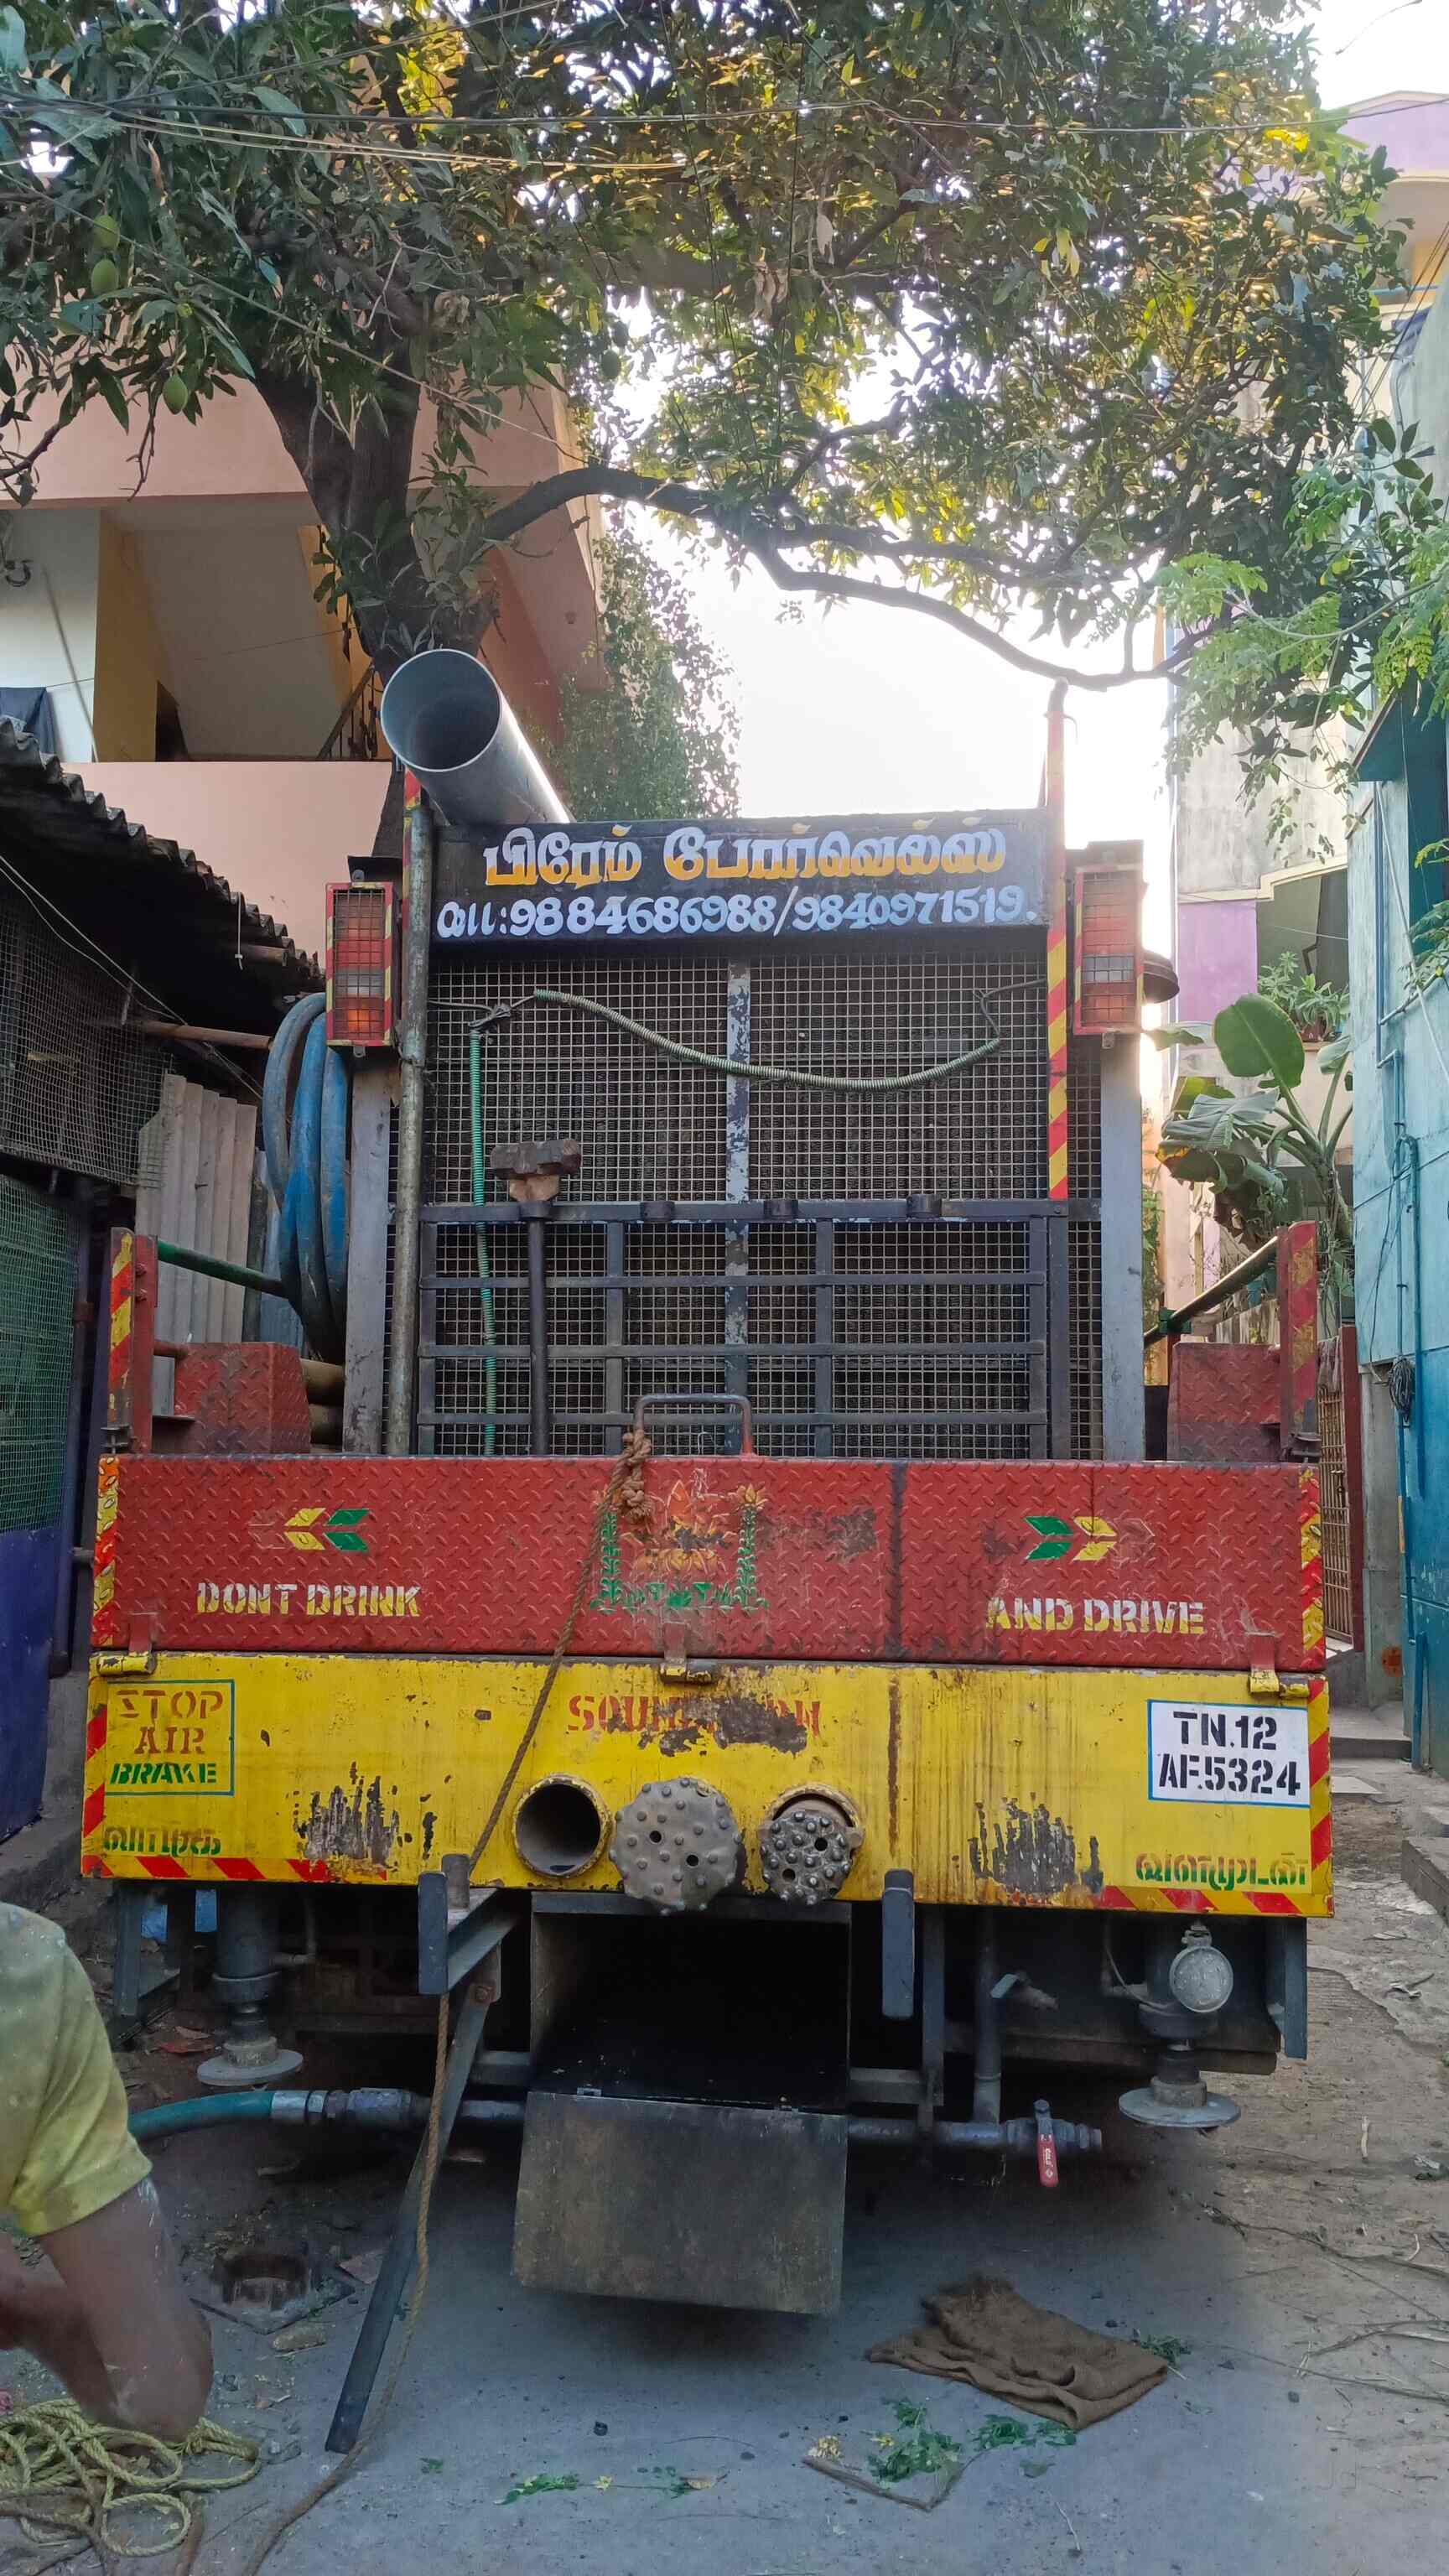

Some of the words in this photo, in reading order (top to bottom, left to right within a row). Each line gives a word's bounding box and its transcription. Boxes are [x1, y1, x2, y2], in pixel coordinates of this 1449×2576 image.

[483, 823, 642, 890] பிரேம்
[197, 1581, 298, 1615] DONT
[307, 1583, 421, 1617] DRINK
[986, 1597, 1074, 1631] AND
[1083, 1598, 1205, 1634] DRIVE
[116, 1690, 224, 1719] STOP
[134, 1726, 205, 1754] AIR
[1173, 1711, 1277, 1750] TN.12
[109, 1762, 217, 1784] BRAKE
[1158, 1753, 1301, 1795] AF.5324
